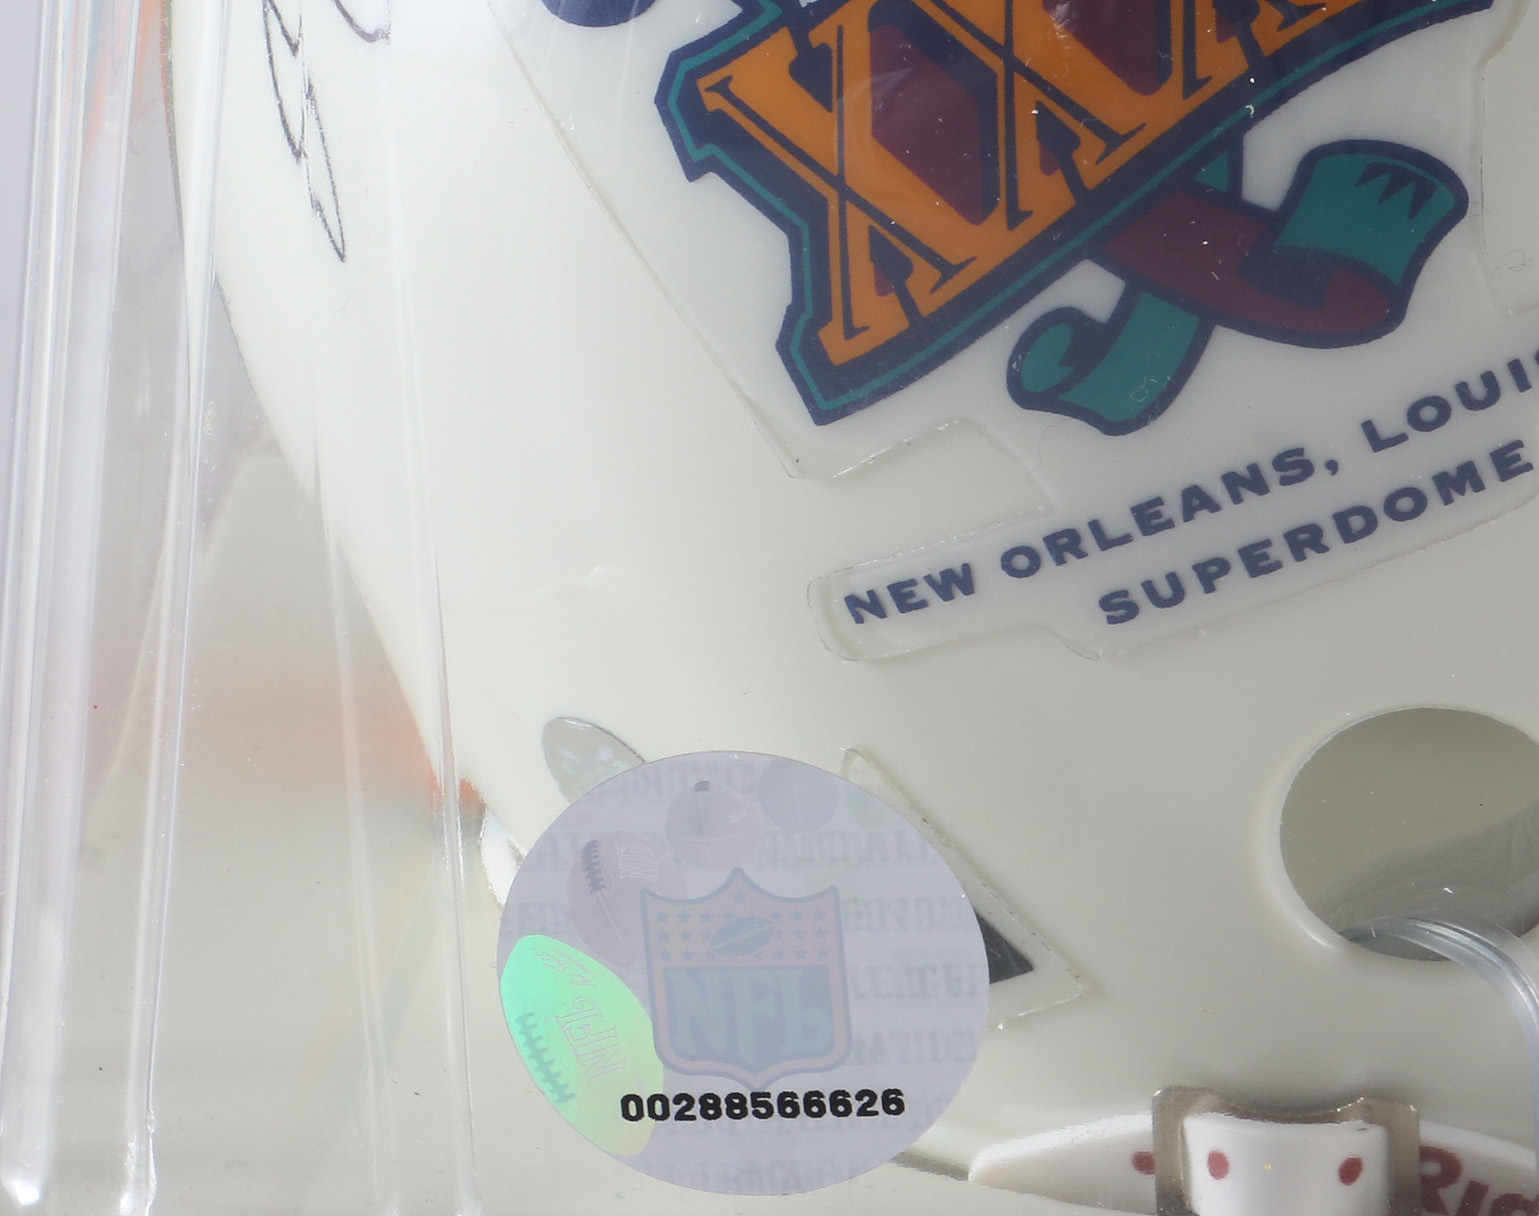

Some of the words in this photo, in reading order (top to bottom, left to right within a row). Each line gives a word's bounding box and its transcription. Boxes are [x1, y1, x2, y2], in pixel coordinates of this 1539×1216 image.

[843, 562, 976, 624] NEW
[999, 447, 1340, 579] ORLEANS,
[1098, 439, 1534, 625] SUPERDOME
[666, 973, 832, 1056] NFL
[620, 1088, 906, 1122] 00288566626
